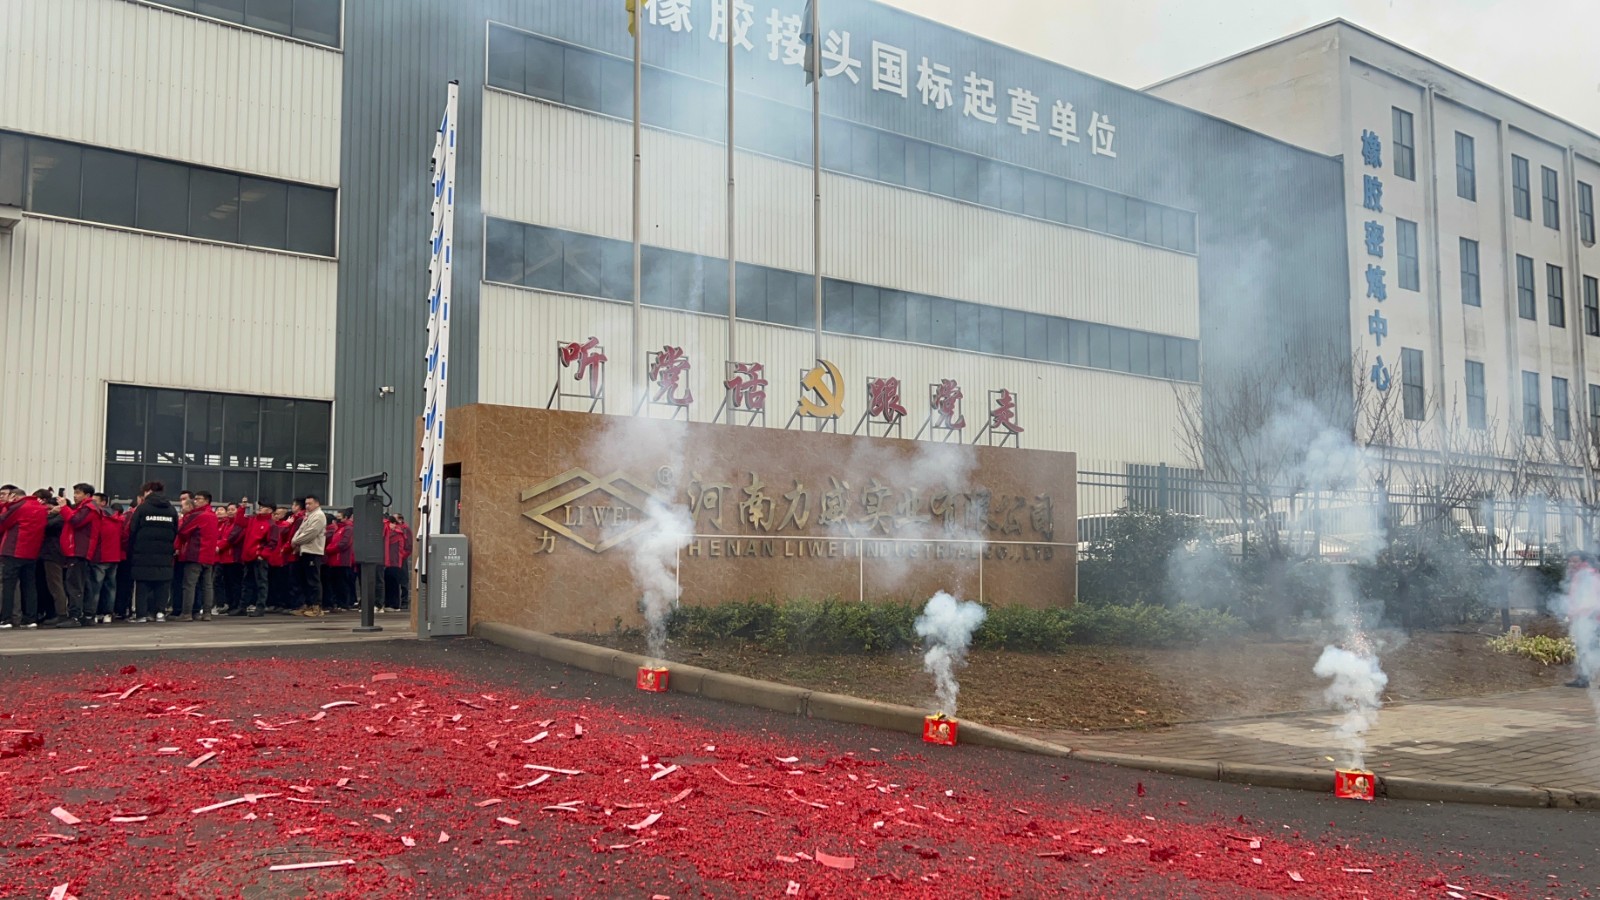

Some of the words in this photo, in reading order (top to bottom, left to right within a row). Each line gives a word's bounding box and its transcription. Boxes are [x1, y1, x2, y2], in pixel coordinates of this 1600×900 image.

[1361, 129, 1390, 391] 橡胶密炼中心
[688, 540, 774, 557] HENAN
